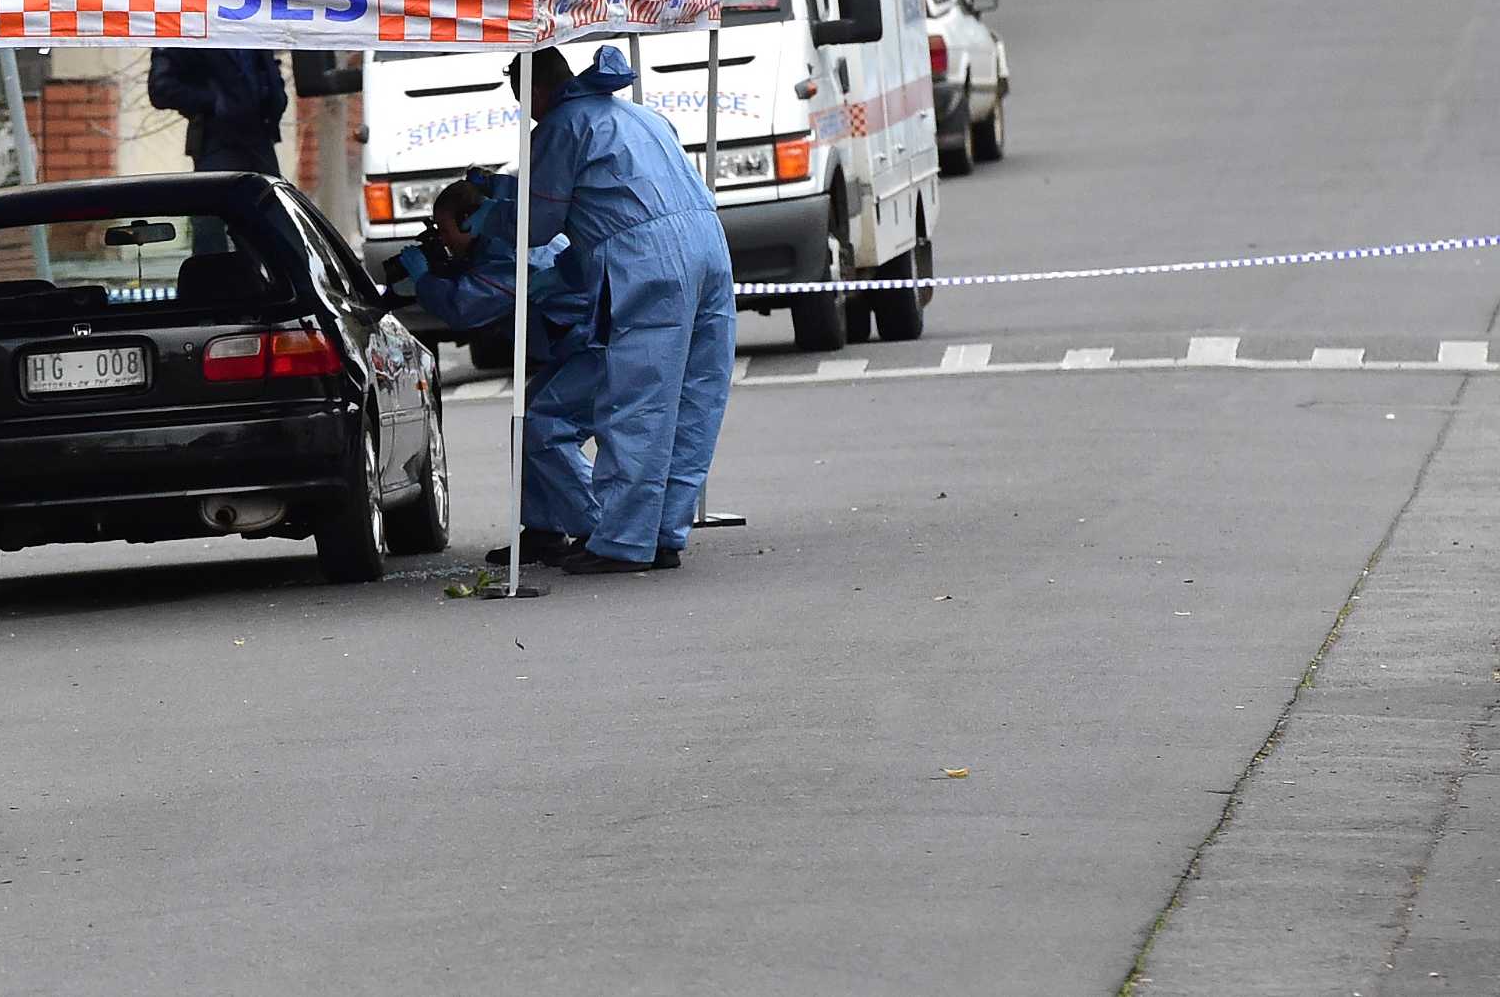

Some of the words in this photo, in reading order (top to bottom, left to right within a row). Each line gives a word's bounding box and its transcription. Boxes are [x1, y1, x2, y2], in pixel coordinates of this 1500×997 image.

[408, 113, 477, 145] STATE
[645, 93, 747, 112] SERVCE
[33, 357, 64, 381] HG
[97, 351, 138, 377] 008
